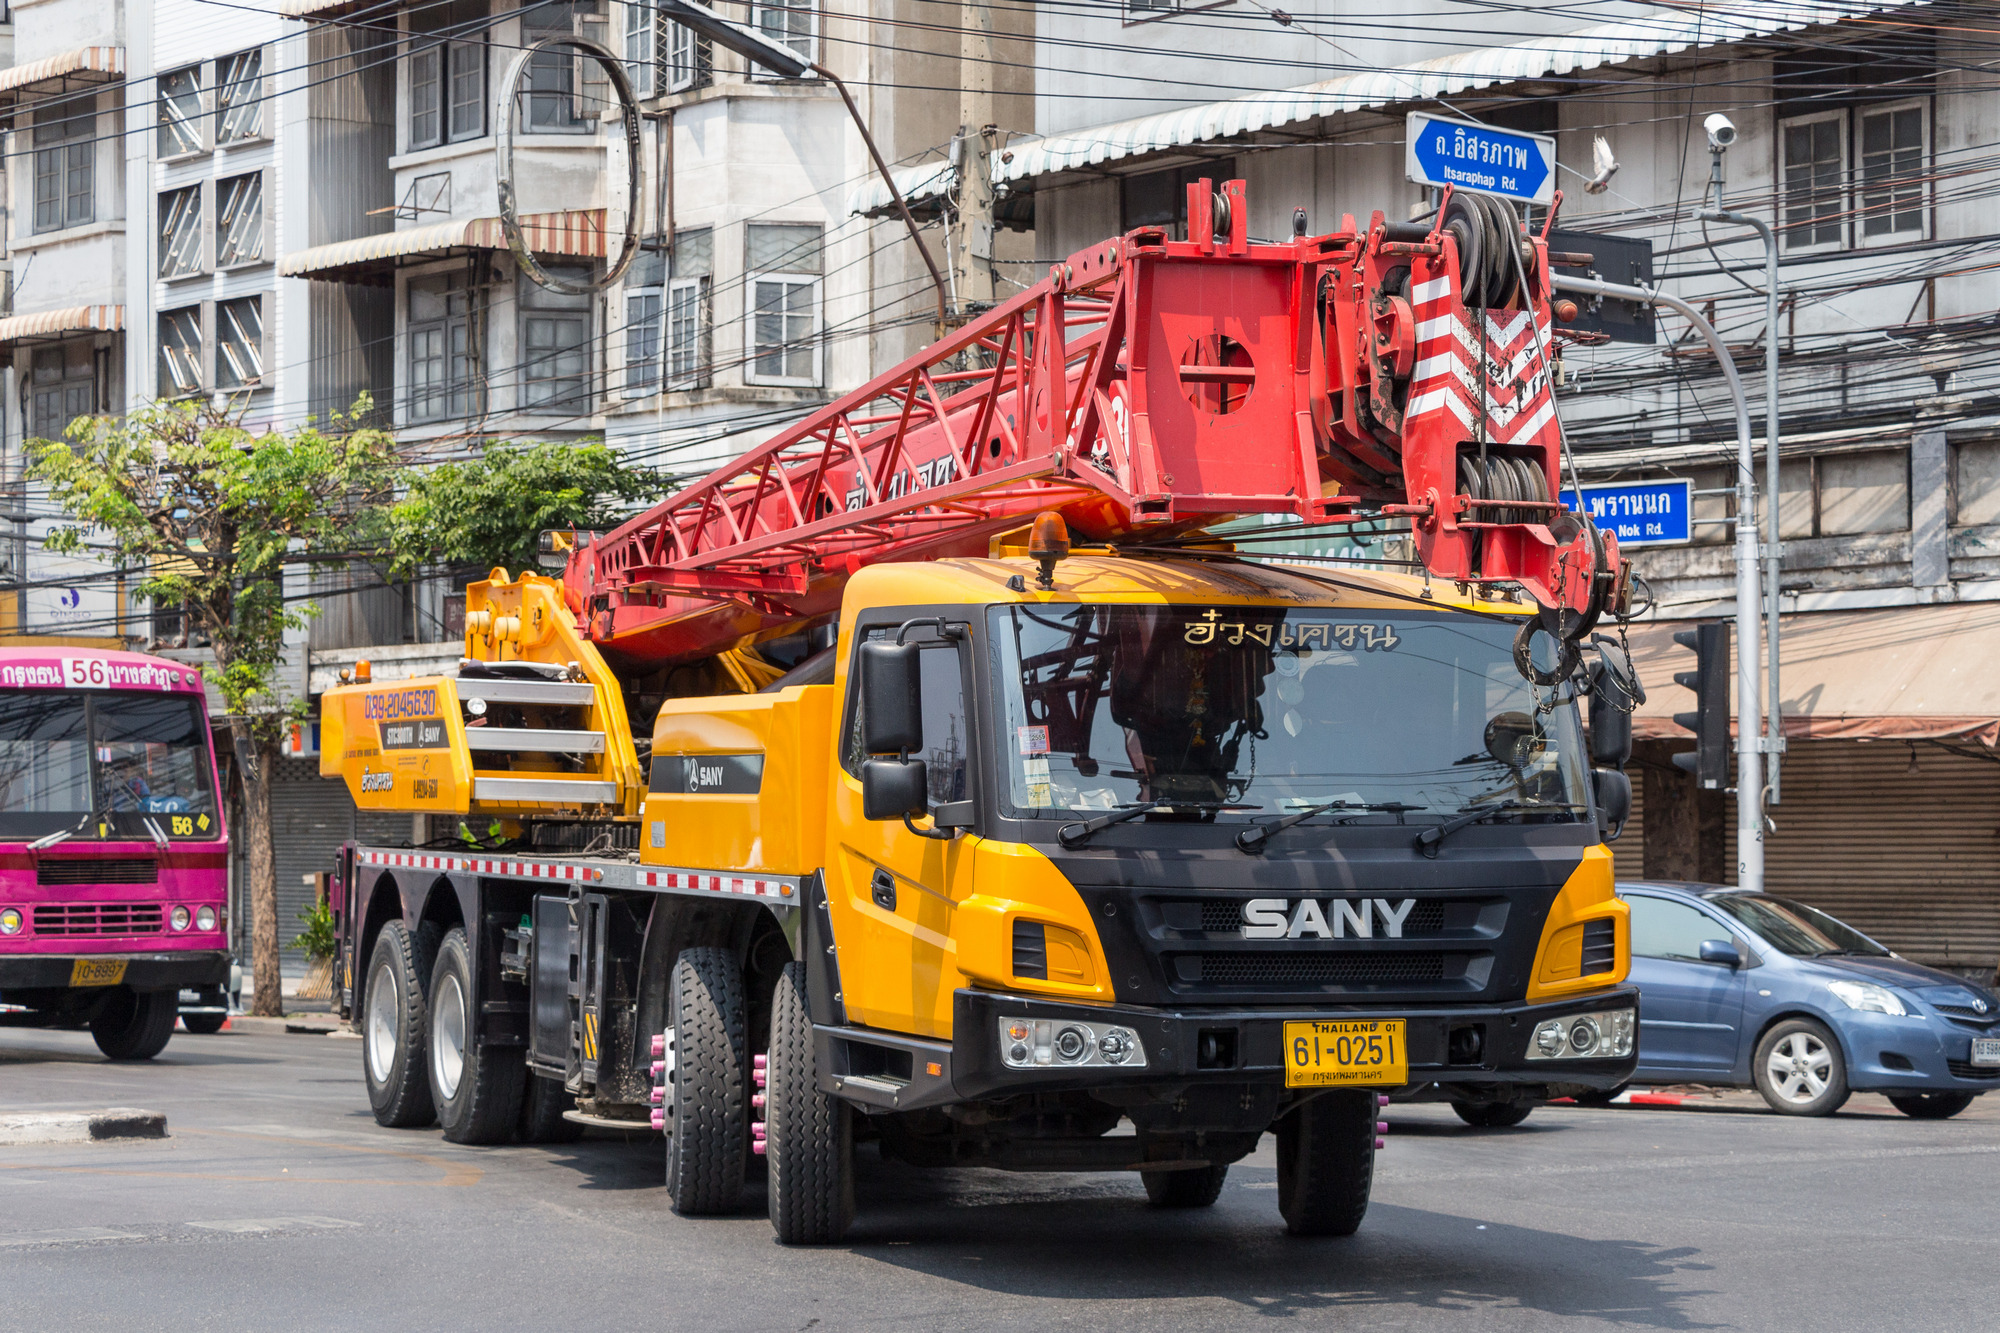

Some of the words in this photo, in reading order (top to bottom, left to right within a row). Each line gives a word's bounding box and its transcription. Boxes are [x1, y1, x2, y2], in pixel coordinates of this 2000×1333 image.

[1454, 128, 1527, 170] อิสรภาพ
[1444, 165, 1495, 189] Itsaraphap
[1501, 176, 1519, 191] Rd.
[1591, 493, 1671, 517] พรานนก
[1618, 524, 1640, 537] Nok
[1646, 522, 1664, 536] Rd.
[72, 660, 105, 684] 56
[365, 689, 436, 720] 089-2045630
[425, 726, 441, 743] SANY
[700, 766, 724, 786] SANY
[172, 815, 193, 836] 56
[1755, 830, 1762, 842] 2
[1740, 862, 1746, 873] 2
[1241, 898, 1417, 939] SANY
[1312, 1023, 1378, 1033] THAILAND
[1385, 1023, 1396, 1032] 01
[1293, 1035, 1395, 1067] 61-0251
[1312, 1071, 1383, 1083] กรุงเทพมหานคร
